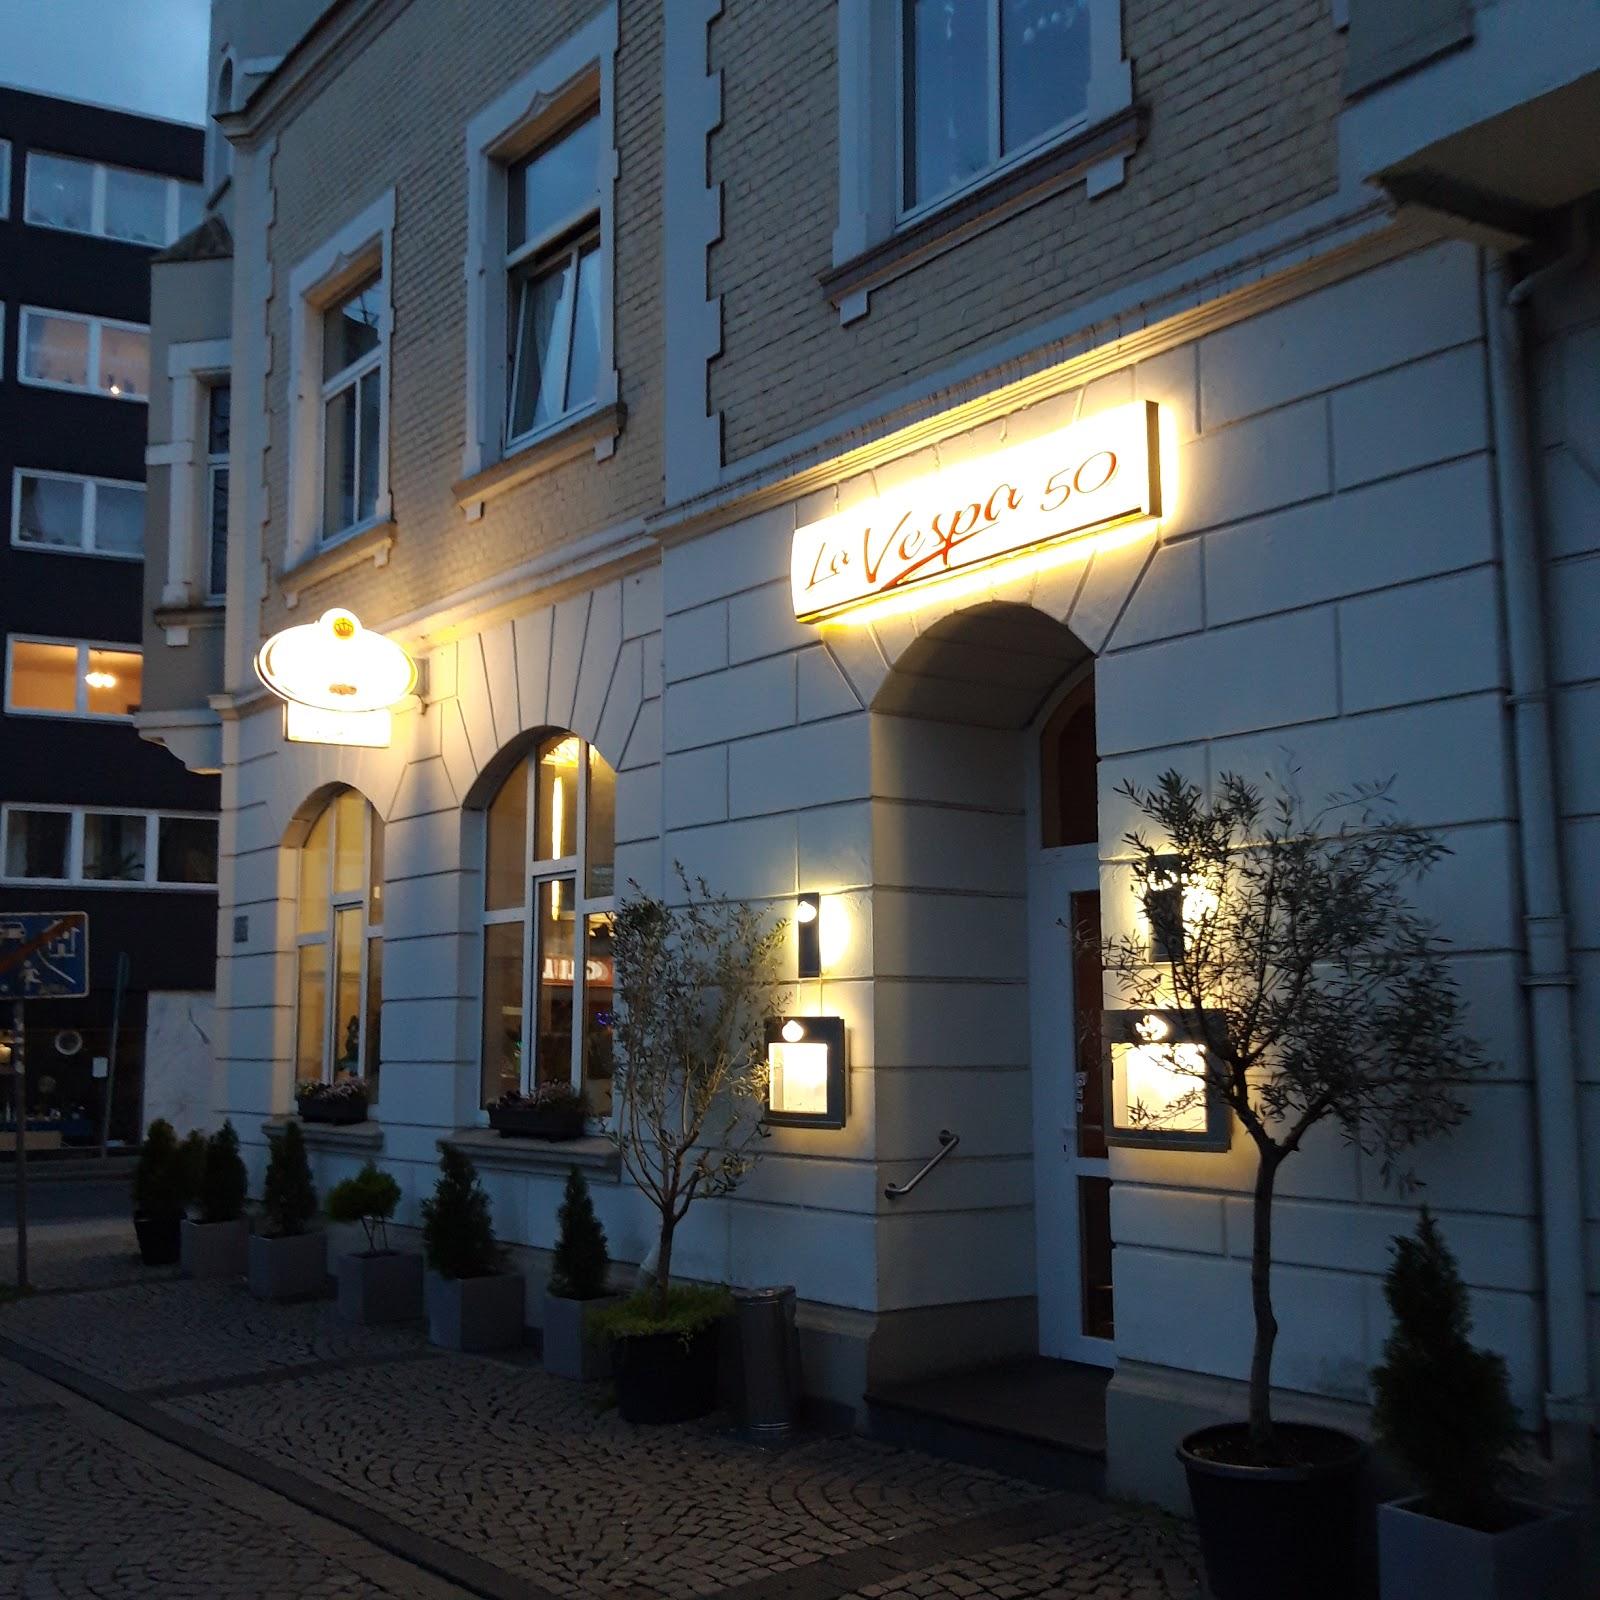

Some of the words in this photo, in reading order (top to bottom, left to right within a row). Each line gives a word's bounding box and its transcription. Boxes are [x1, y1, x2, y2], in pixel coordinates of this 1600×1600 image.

[804, 541, 851, 592] La
[863, 482, 1023, 590] Vespa
[1039, 450, 1119, 512] 50
